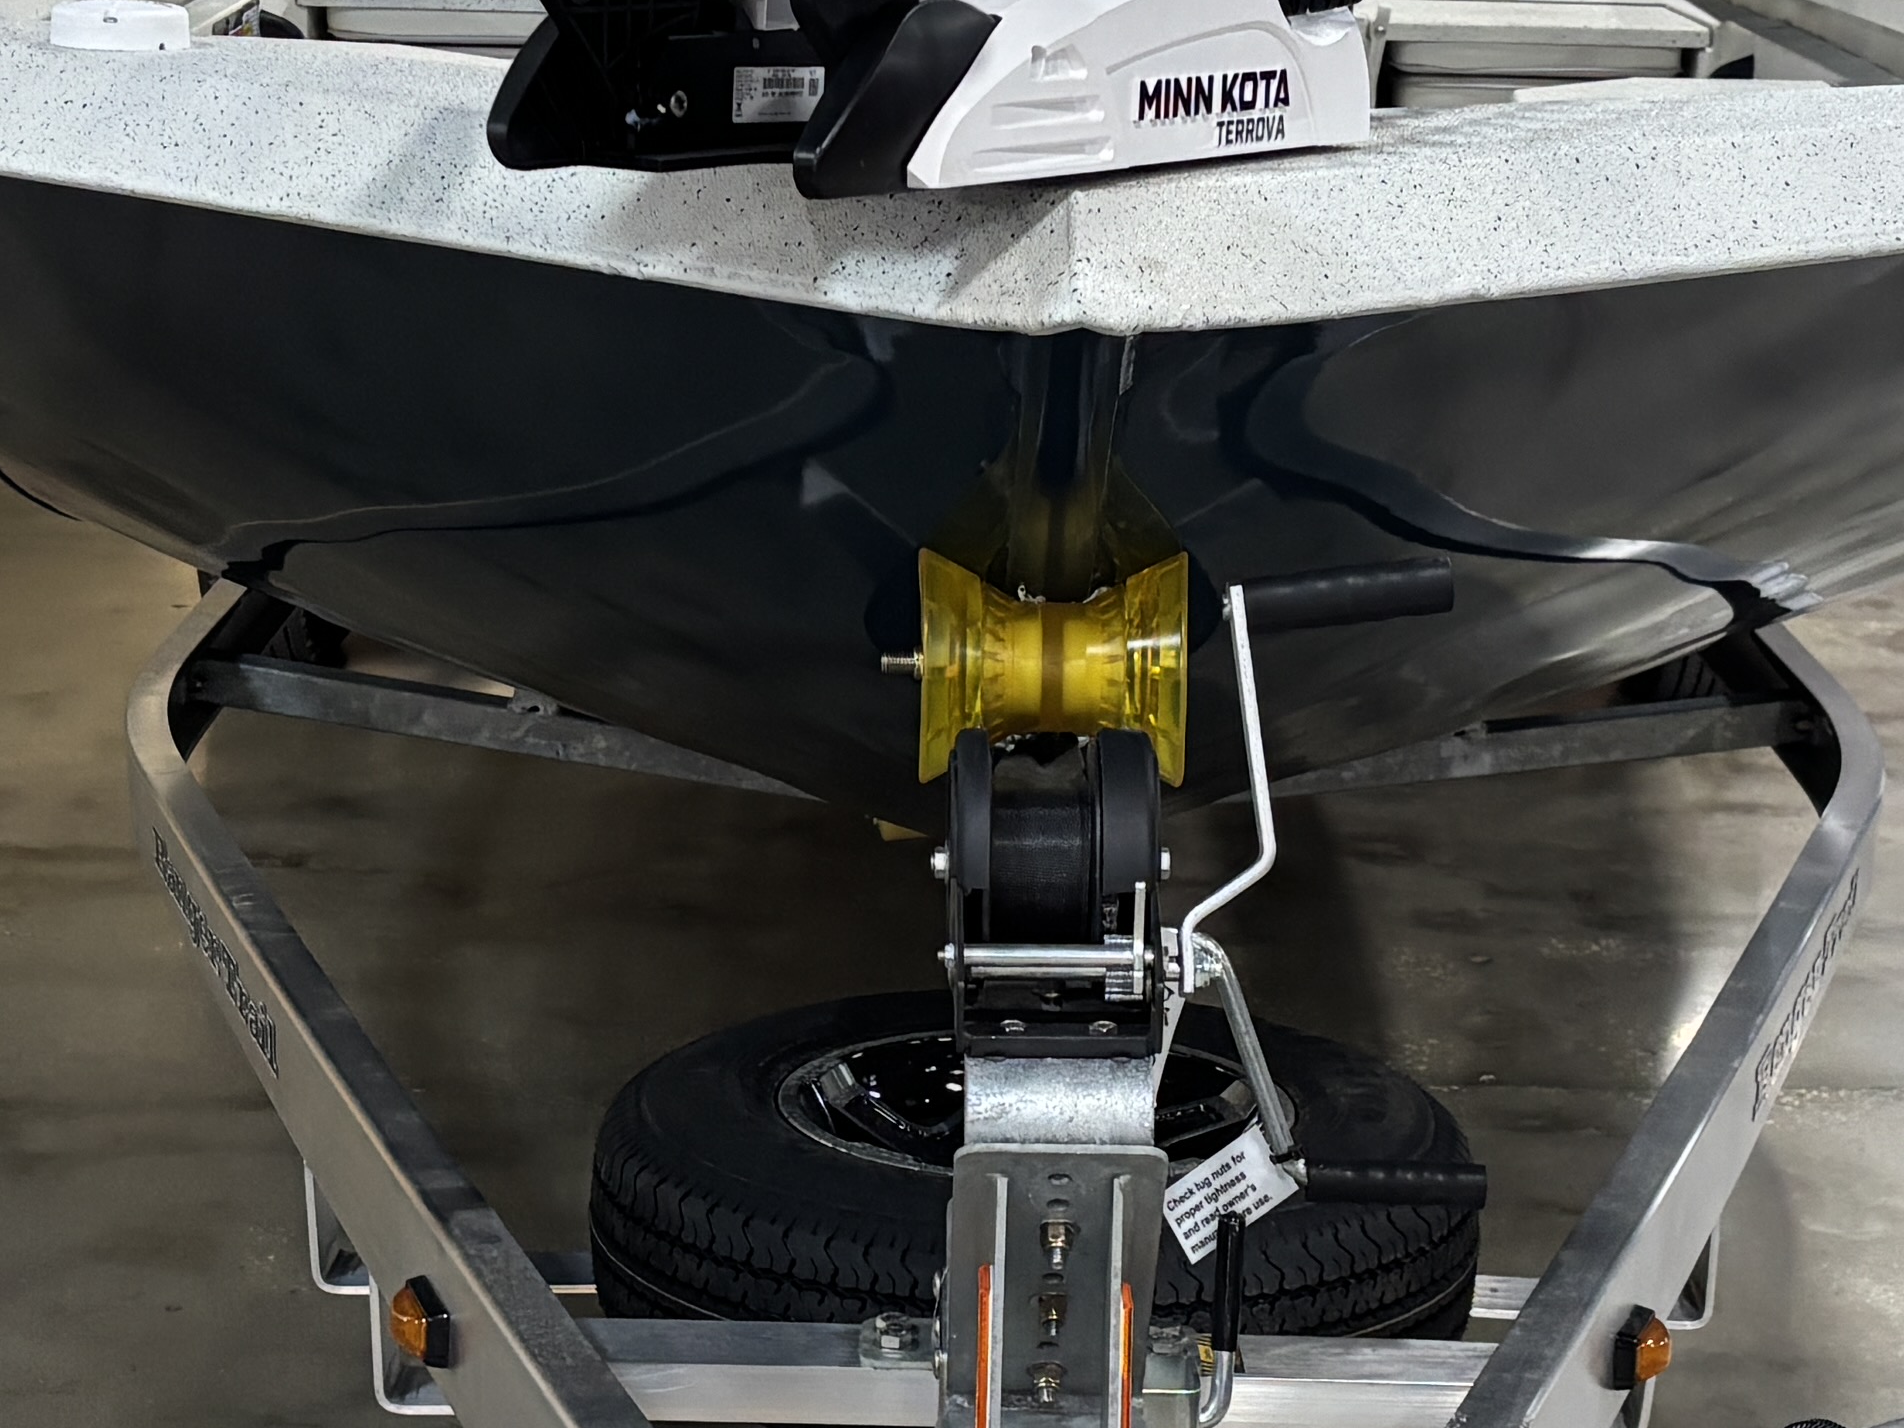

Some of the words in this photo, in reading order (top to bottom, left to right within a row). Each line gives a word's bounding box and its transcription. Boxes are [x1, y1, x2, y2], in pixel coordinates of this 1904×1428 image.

[1137, 74, 1214, 122] MINN
[1220, 68, 1291, 114] KOTA
[1216, 115, 1286, 148] TERROVA
[1166, 1187, 1196, 1212] Check
[1195, 1176, 1212, 1194] lug
[1211, 1163, 1232, 1181] nuts
[1231, 1151, 1246, 1166] for
[1174, 1199, 1205, 1229] proper
[1204, 1172, 1247, 1205] tightness
[1252, 1193, 1274, 1210] use.
[1182, 1222, 1201, 1240] and
[1200, 1207, 1221, 1229] read
[1223, 1183, 1257, 1213] owner's
